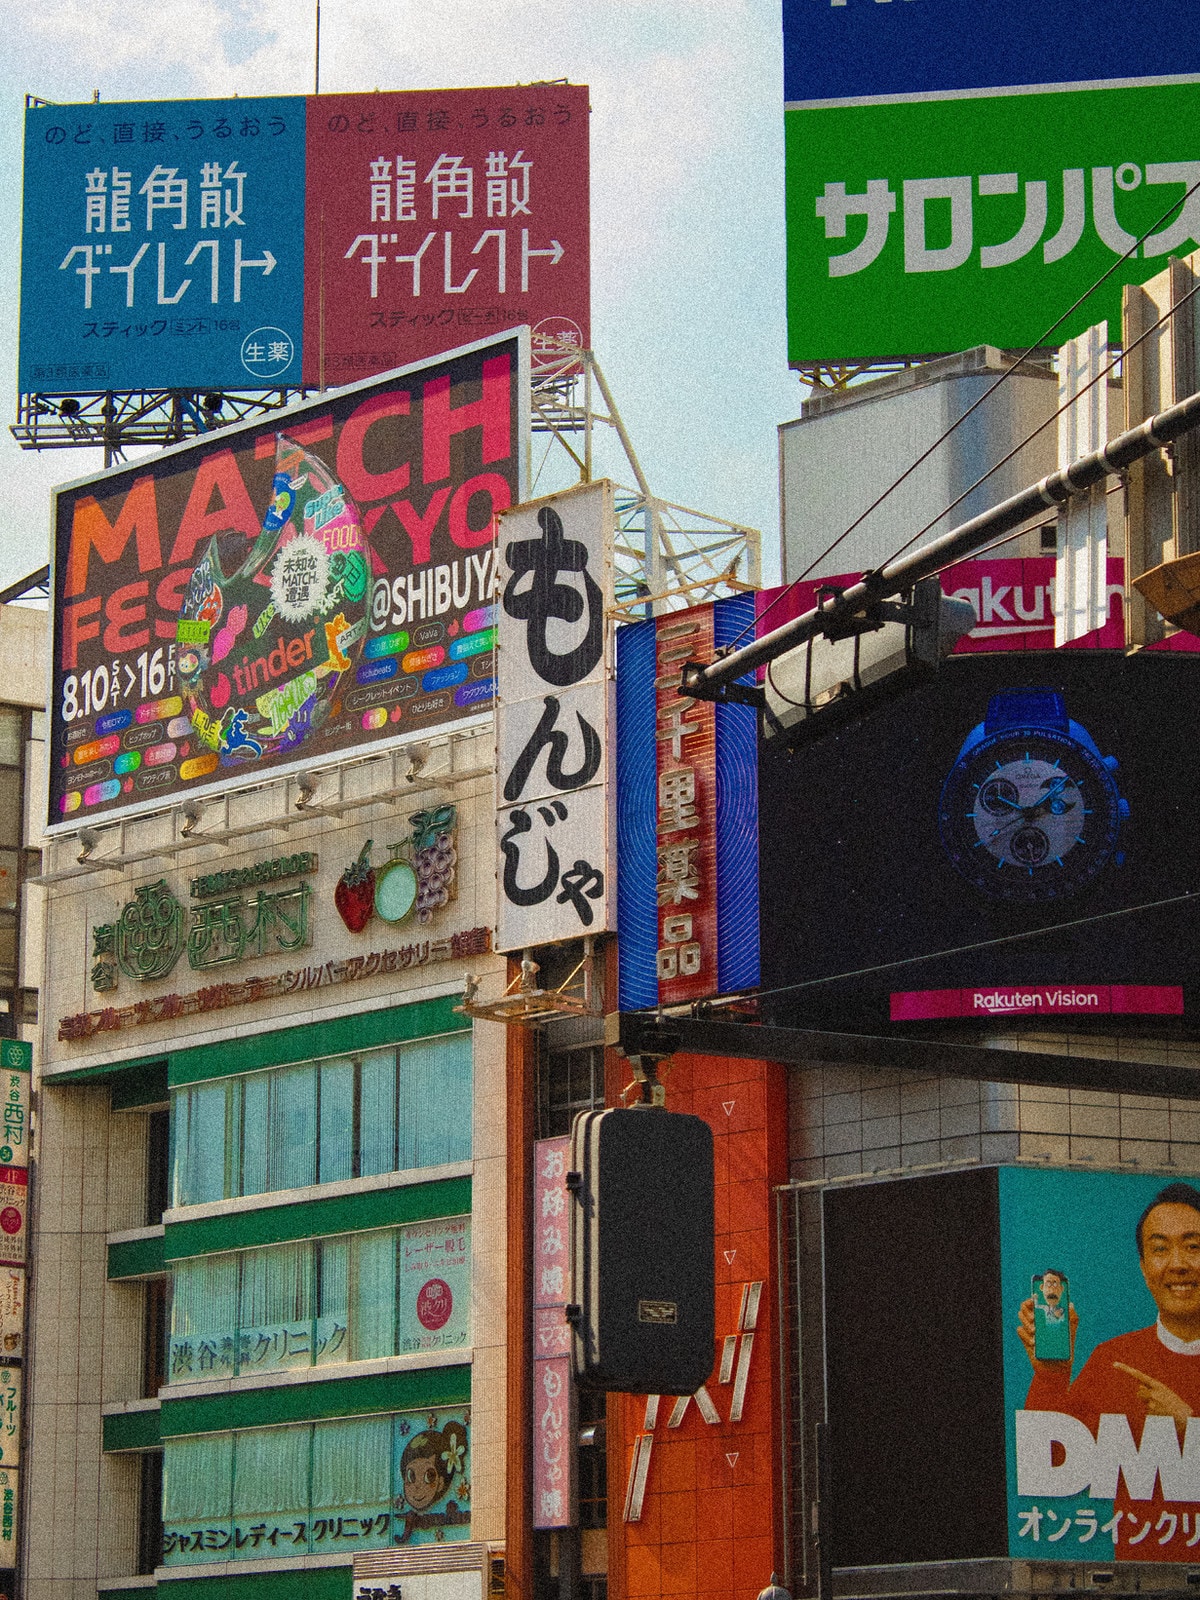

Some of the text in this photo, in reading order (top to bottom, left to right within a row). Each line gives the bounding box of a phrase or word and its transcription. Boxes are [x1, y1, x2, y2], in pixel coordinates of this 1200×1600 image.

[45, 116, 287, 145] のど、直接、うるおう
[85, 161, 247, 233] 龍角散
[370, 150, 533, 222] 龍角散
[816, 160, 1200, 277] サロンパス
[59, 239, 277, 309] ダイレクト
[344, 228, 565, 298] ダイレクト
[83, 319, 168, 338] スティック
[245, 341, 289, 363] 生薬
[370, 309, 454, 328] スティック
[284, 556, 318, 573] 未知な
[285, 586, 310, 602] 遭遇
[62, 643, 176, 722] 8.10 SAT 16 FRI
[233, 627, 316, 696] tinder
[503, 506, 604, 926] もんじゃ
[655, 621, 700, 981] 三千里薬品
[91, 923, 116, 992] 渋谷
[187, 880, 314, 972] 西村
[973, 989, 1099, 1012] Rakuten Vision
[9, 1073, 21, 1102] 渋谷
[3, 1102, 25, 1146] 西村
[405, 1236, 466, 1258] レーザー脱毛
[541, 1148, 565, 1295] お好み焼
[6, 1387, 17, 1437] フルーツ
[540, 1365, 564, 1519] もんじゃ焼
[163, 1513, 390, 1556] ジャスミンレディースクリニック
